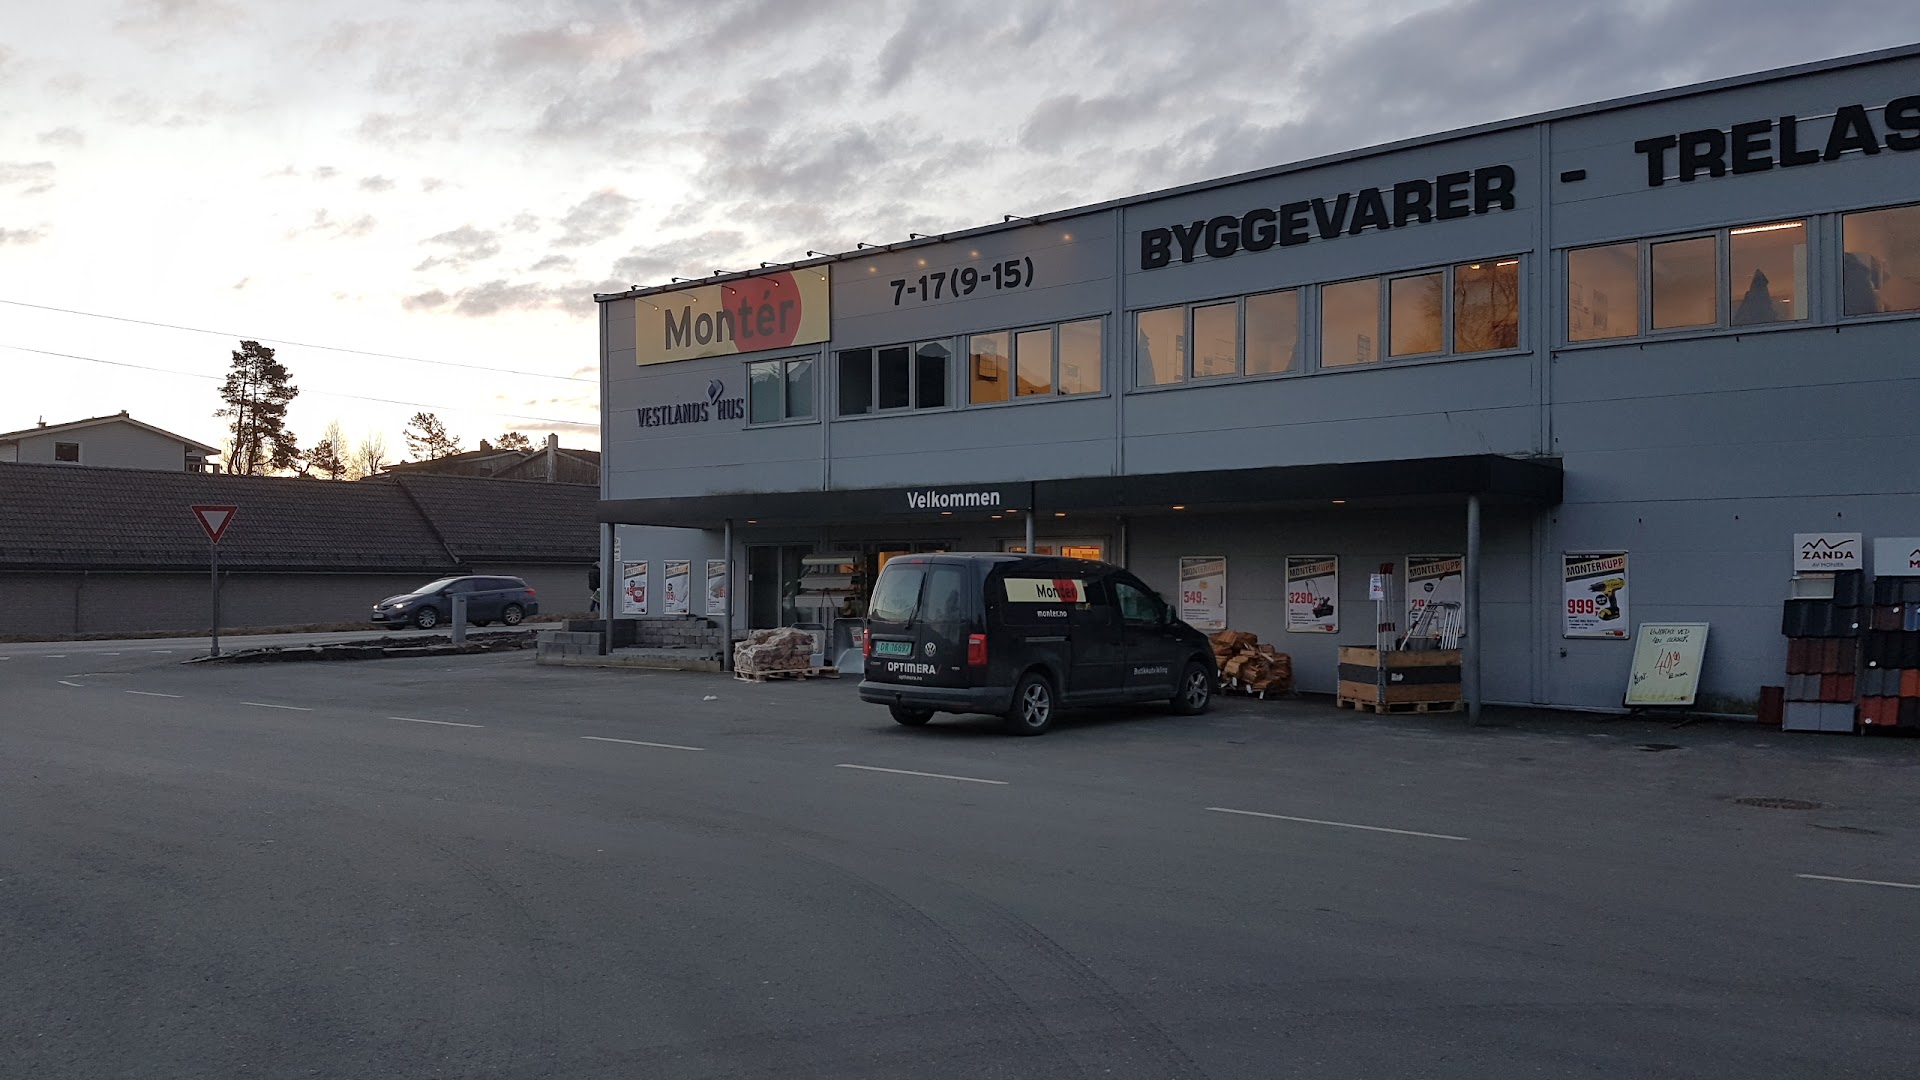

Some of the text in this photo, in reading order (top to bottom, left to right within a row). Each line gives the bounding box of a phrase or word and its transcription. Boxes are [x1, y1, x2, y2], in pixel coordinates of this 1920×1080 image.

[1140, 164, 1517, 270] BYGGEVARER
[664, 291, 795, 350] Montér
[637, 398, 745, 428] VESTLANDS HUS
[907, 489, 1001, 510] Velkommen
[1802, 551, 1855, 560] ZANDA
[887, 661, 936, 675] OPTIMERA
